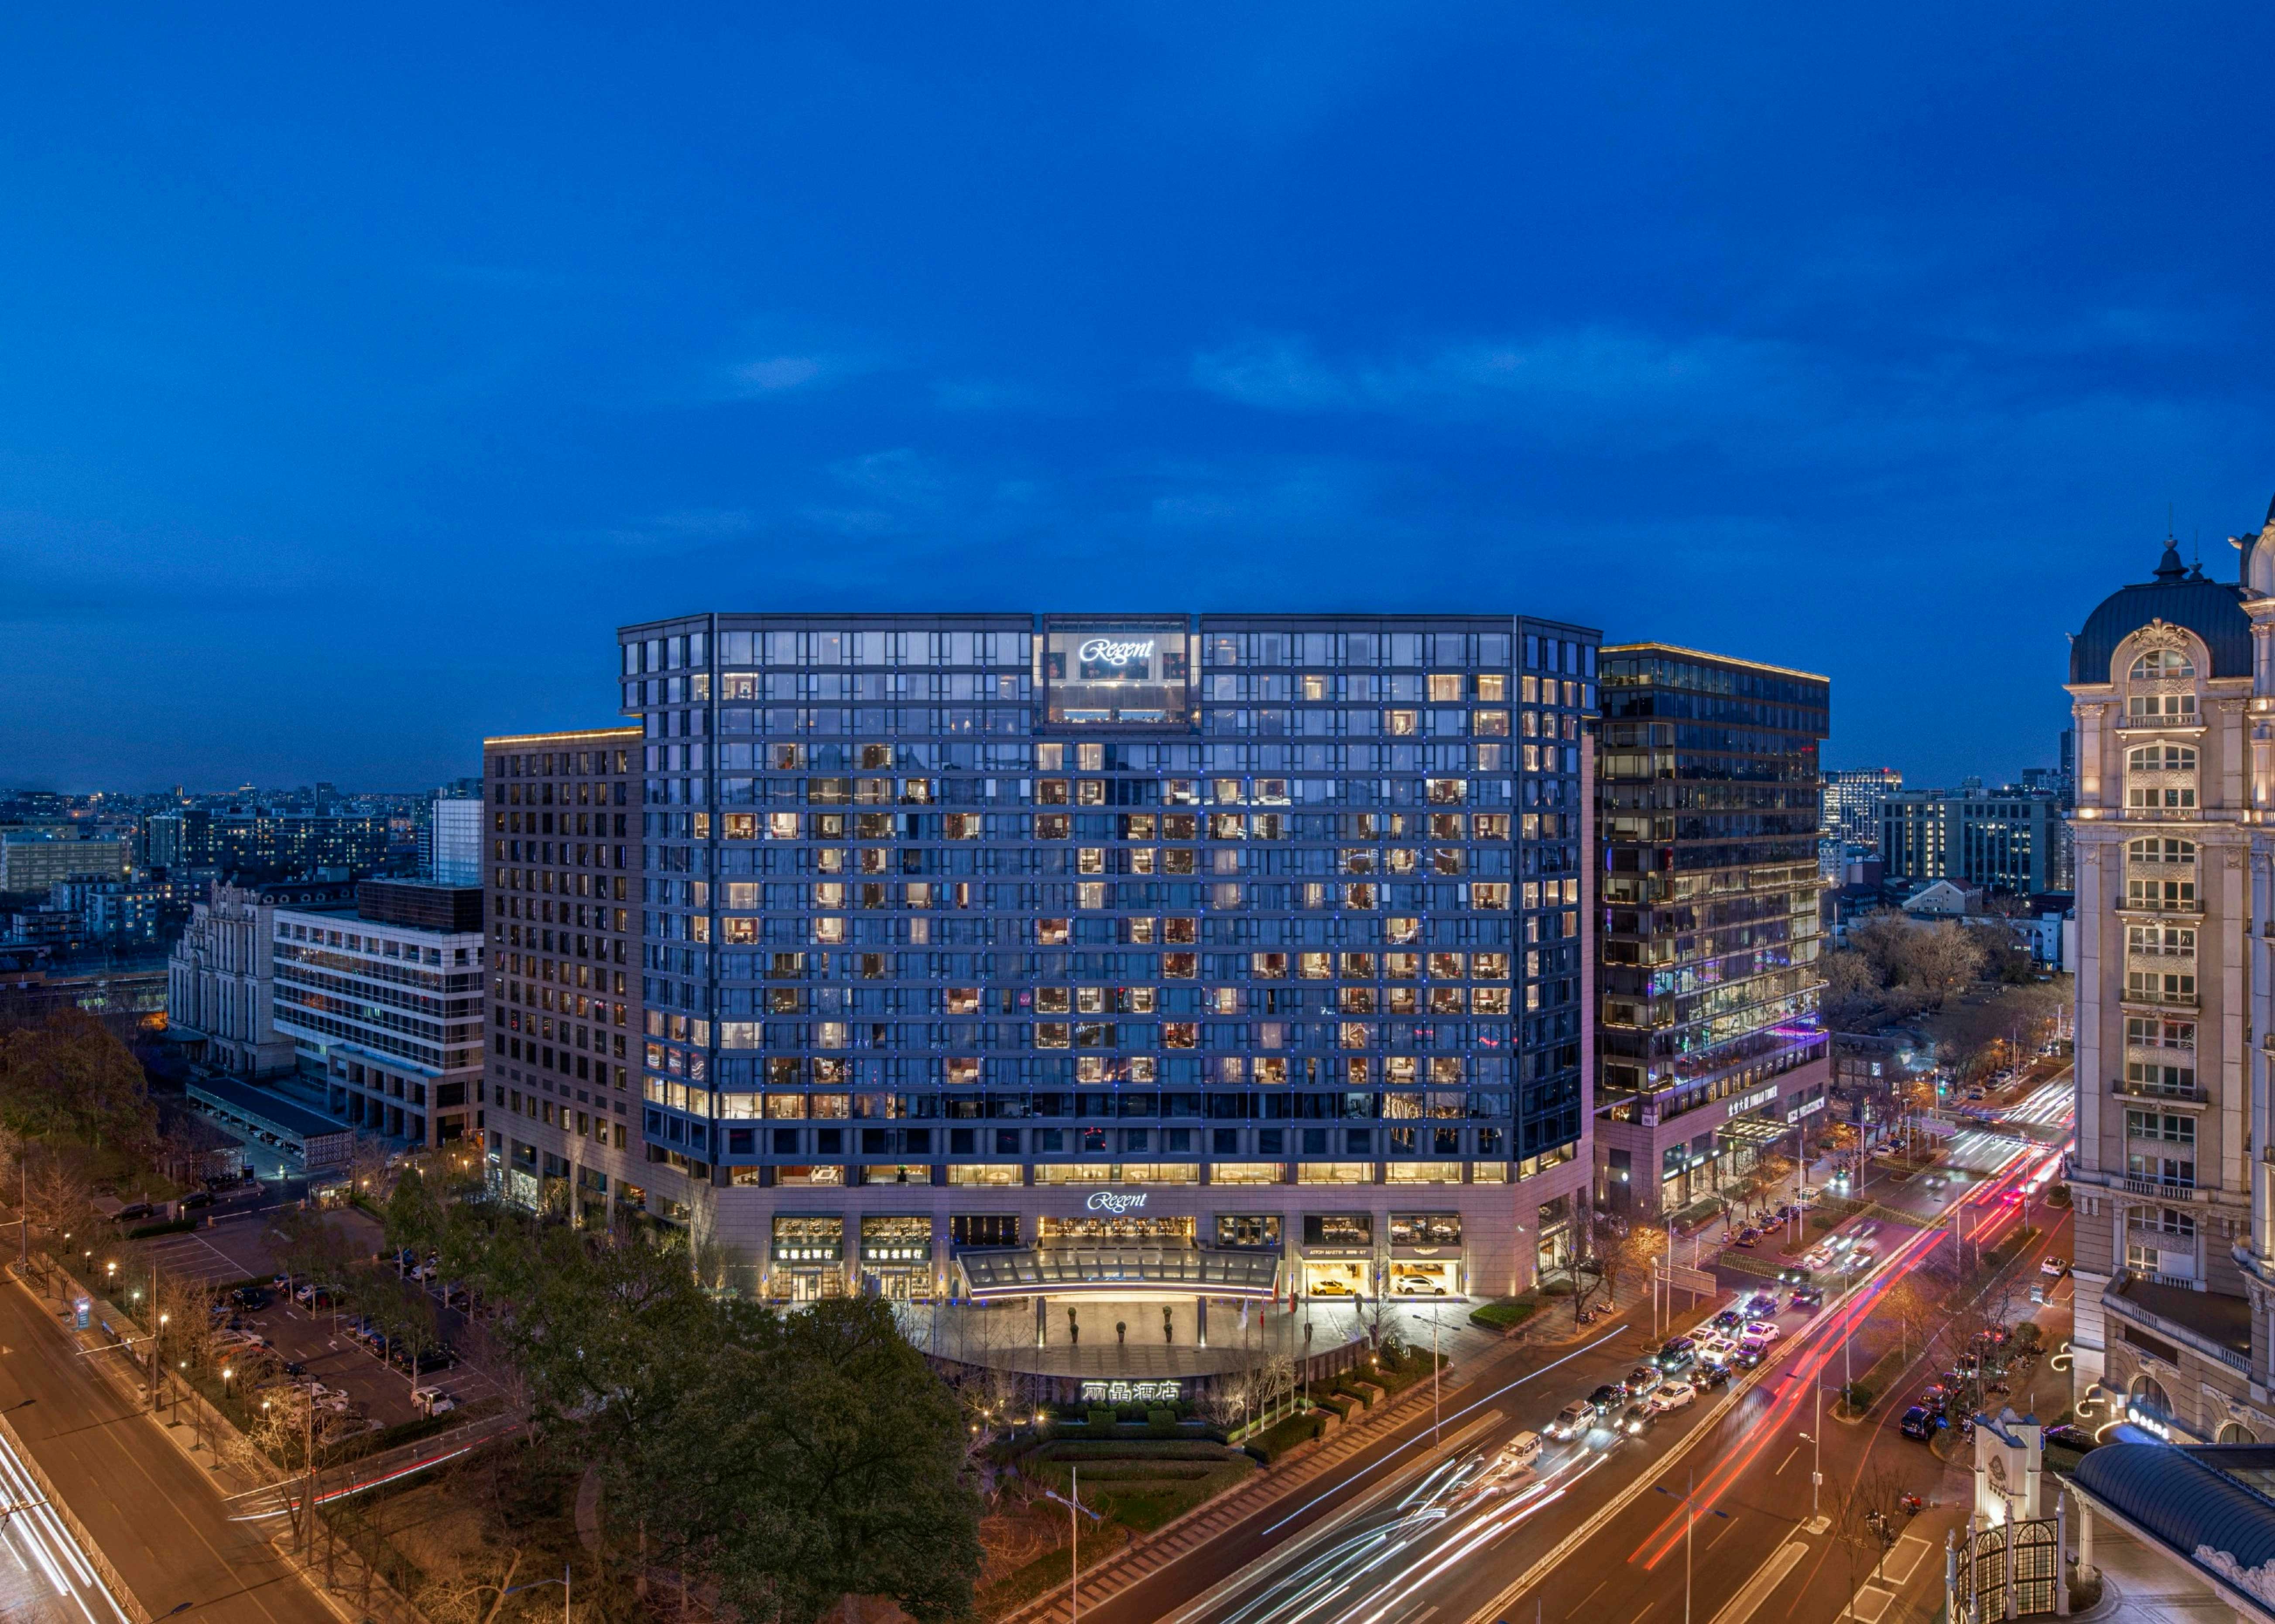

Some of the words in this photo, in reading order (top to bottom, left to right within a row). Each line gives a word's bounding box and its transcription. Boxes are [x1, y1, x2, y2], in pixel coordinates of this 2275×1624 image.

[1080, 639, 1154, 665] Regent
[1087, 1192, 1148, 1213] Regent
[1083, 1380, 1181, 1401] 丽晶酒店
